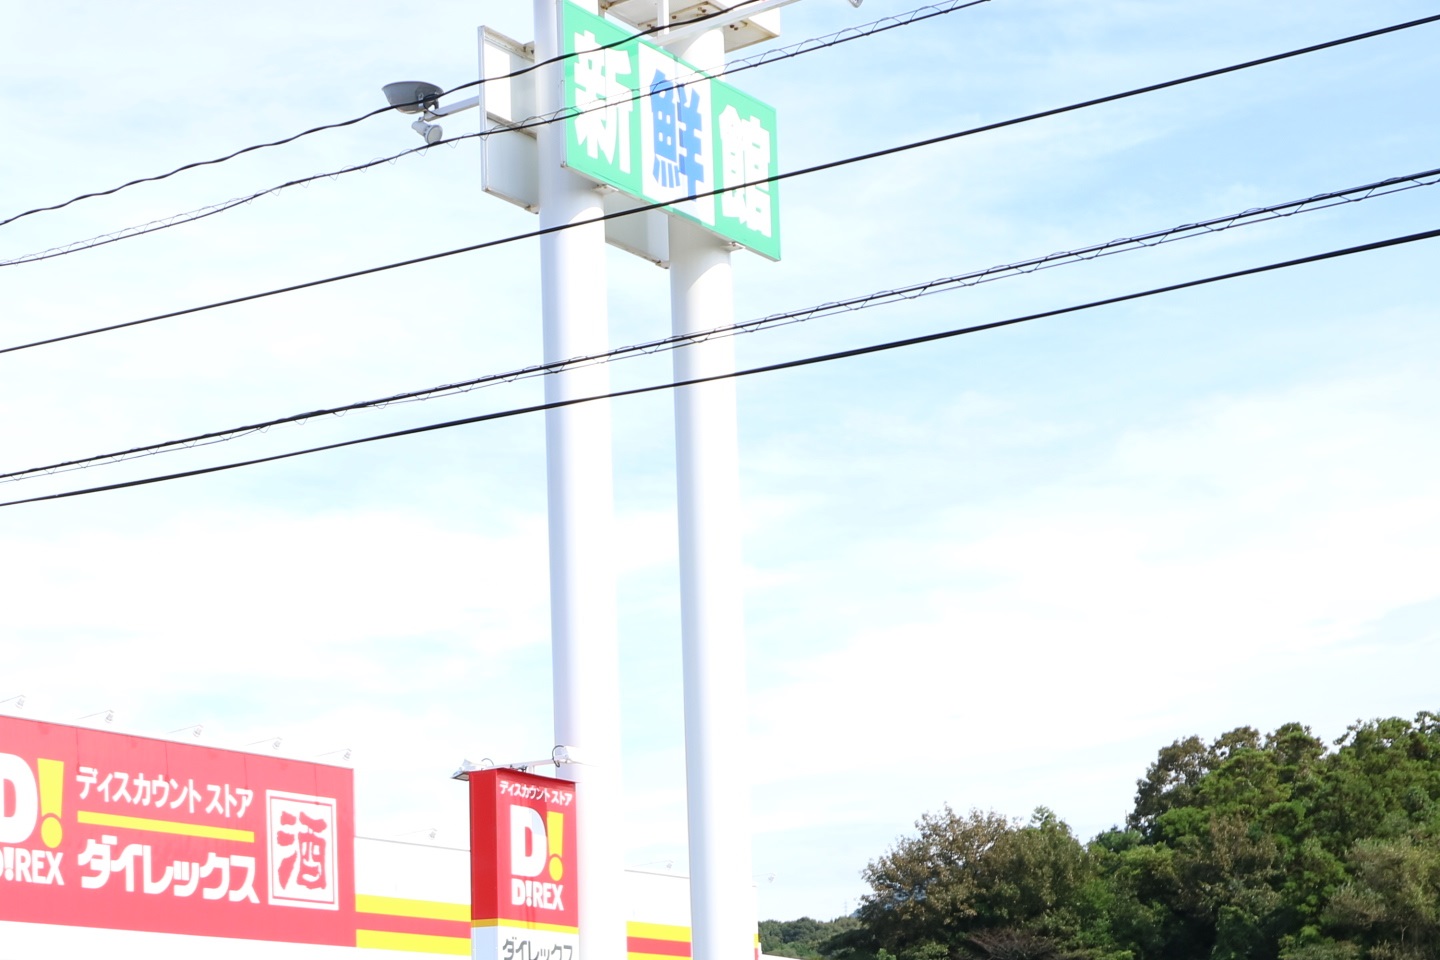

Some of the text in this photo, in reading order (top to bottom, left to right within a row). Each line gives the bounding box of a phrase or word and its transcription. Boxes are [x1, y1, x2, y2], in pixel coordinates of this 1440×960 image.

[573, 30, 772, 239] 新鮮館
[76, 766, 253, 818] ディスカウントストア
[499, 780, 573, 806] ディスカウントストア
[77, 834, 260, 904] ダイレックス
[276, 810, 327, 892] 酒
